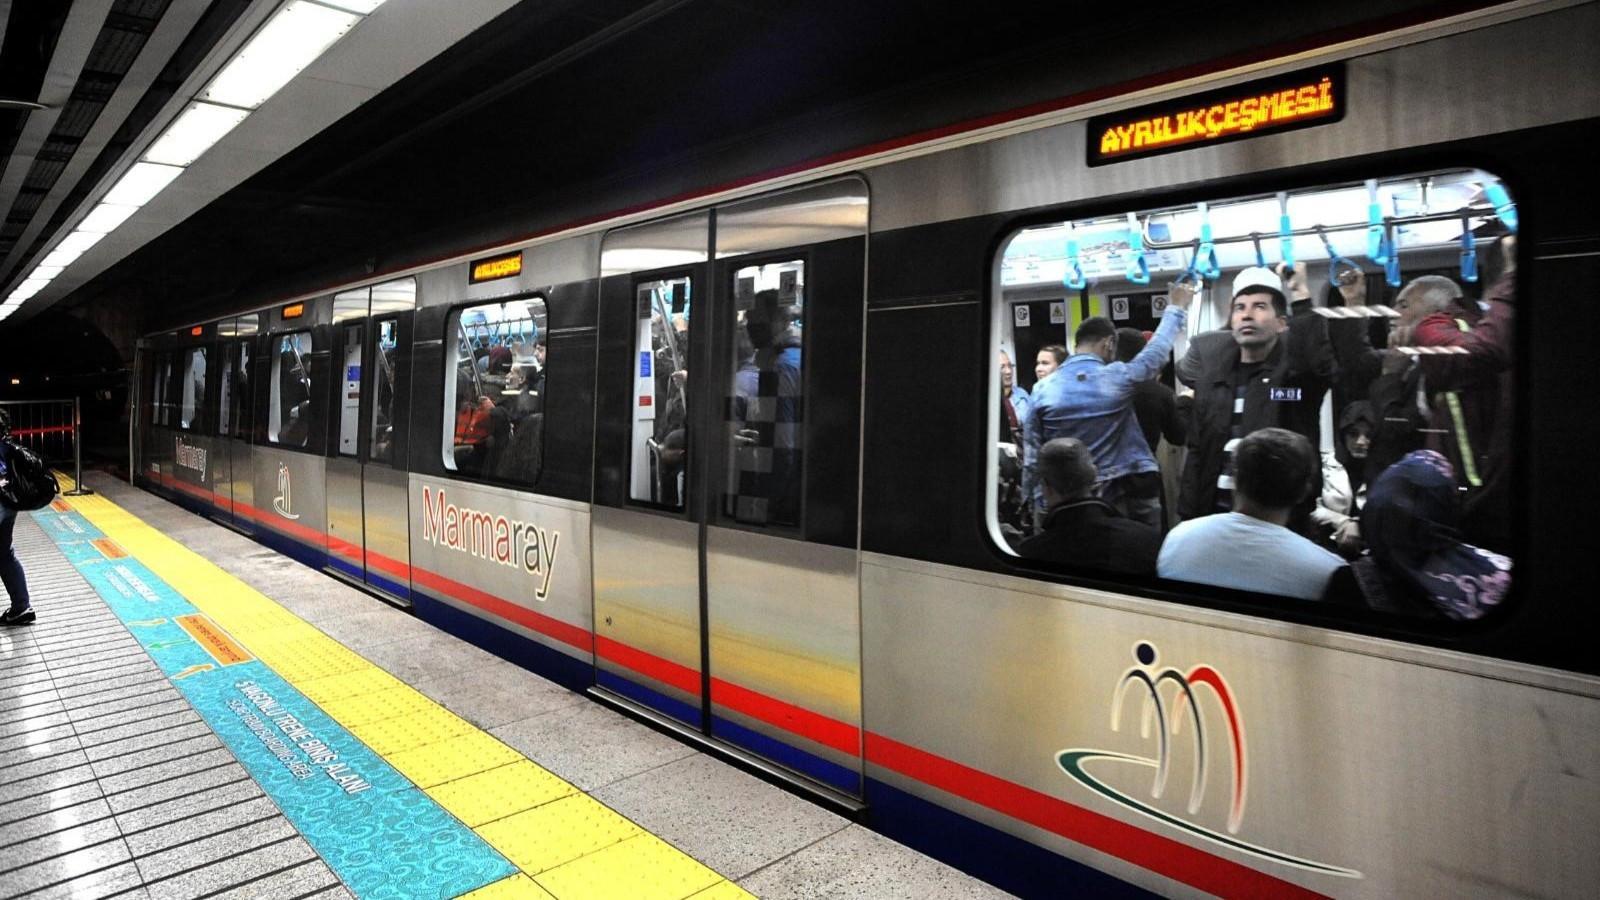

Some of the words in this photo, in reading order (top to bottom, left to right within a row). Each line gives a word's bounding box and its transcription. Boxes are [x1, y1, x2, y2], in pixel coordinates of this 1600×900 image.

[1101, 77, 1333, 153] AYRILIKÇEŞMESİ
[423, 486, 560, 600] Marmaray
[272, 713, 315, 743] TRENE
[321, 762, 372, 794] ALANI
